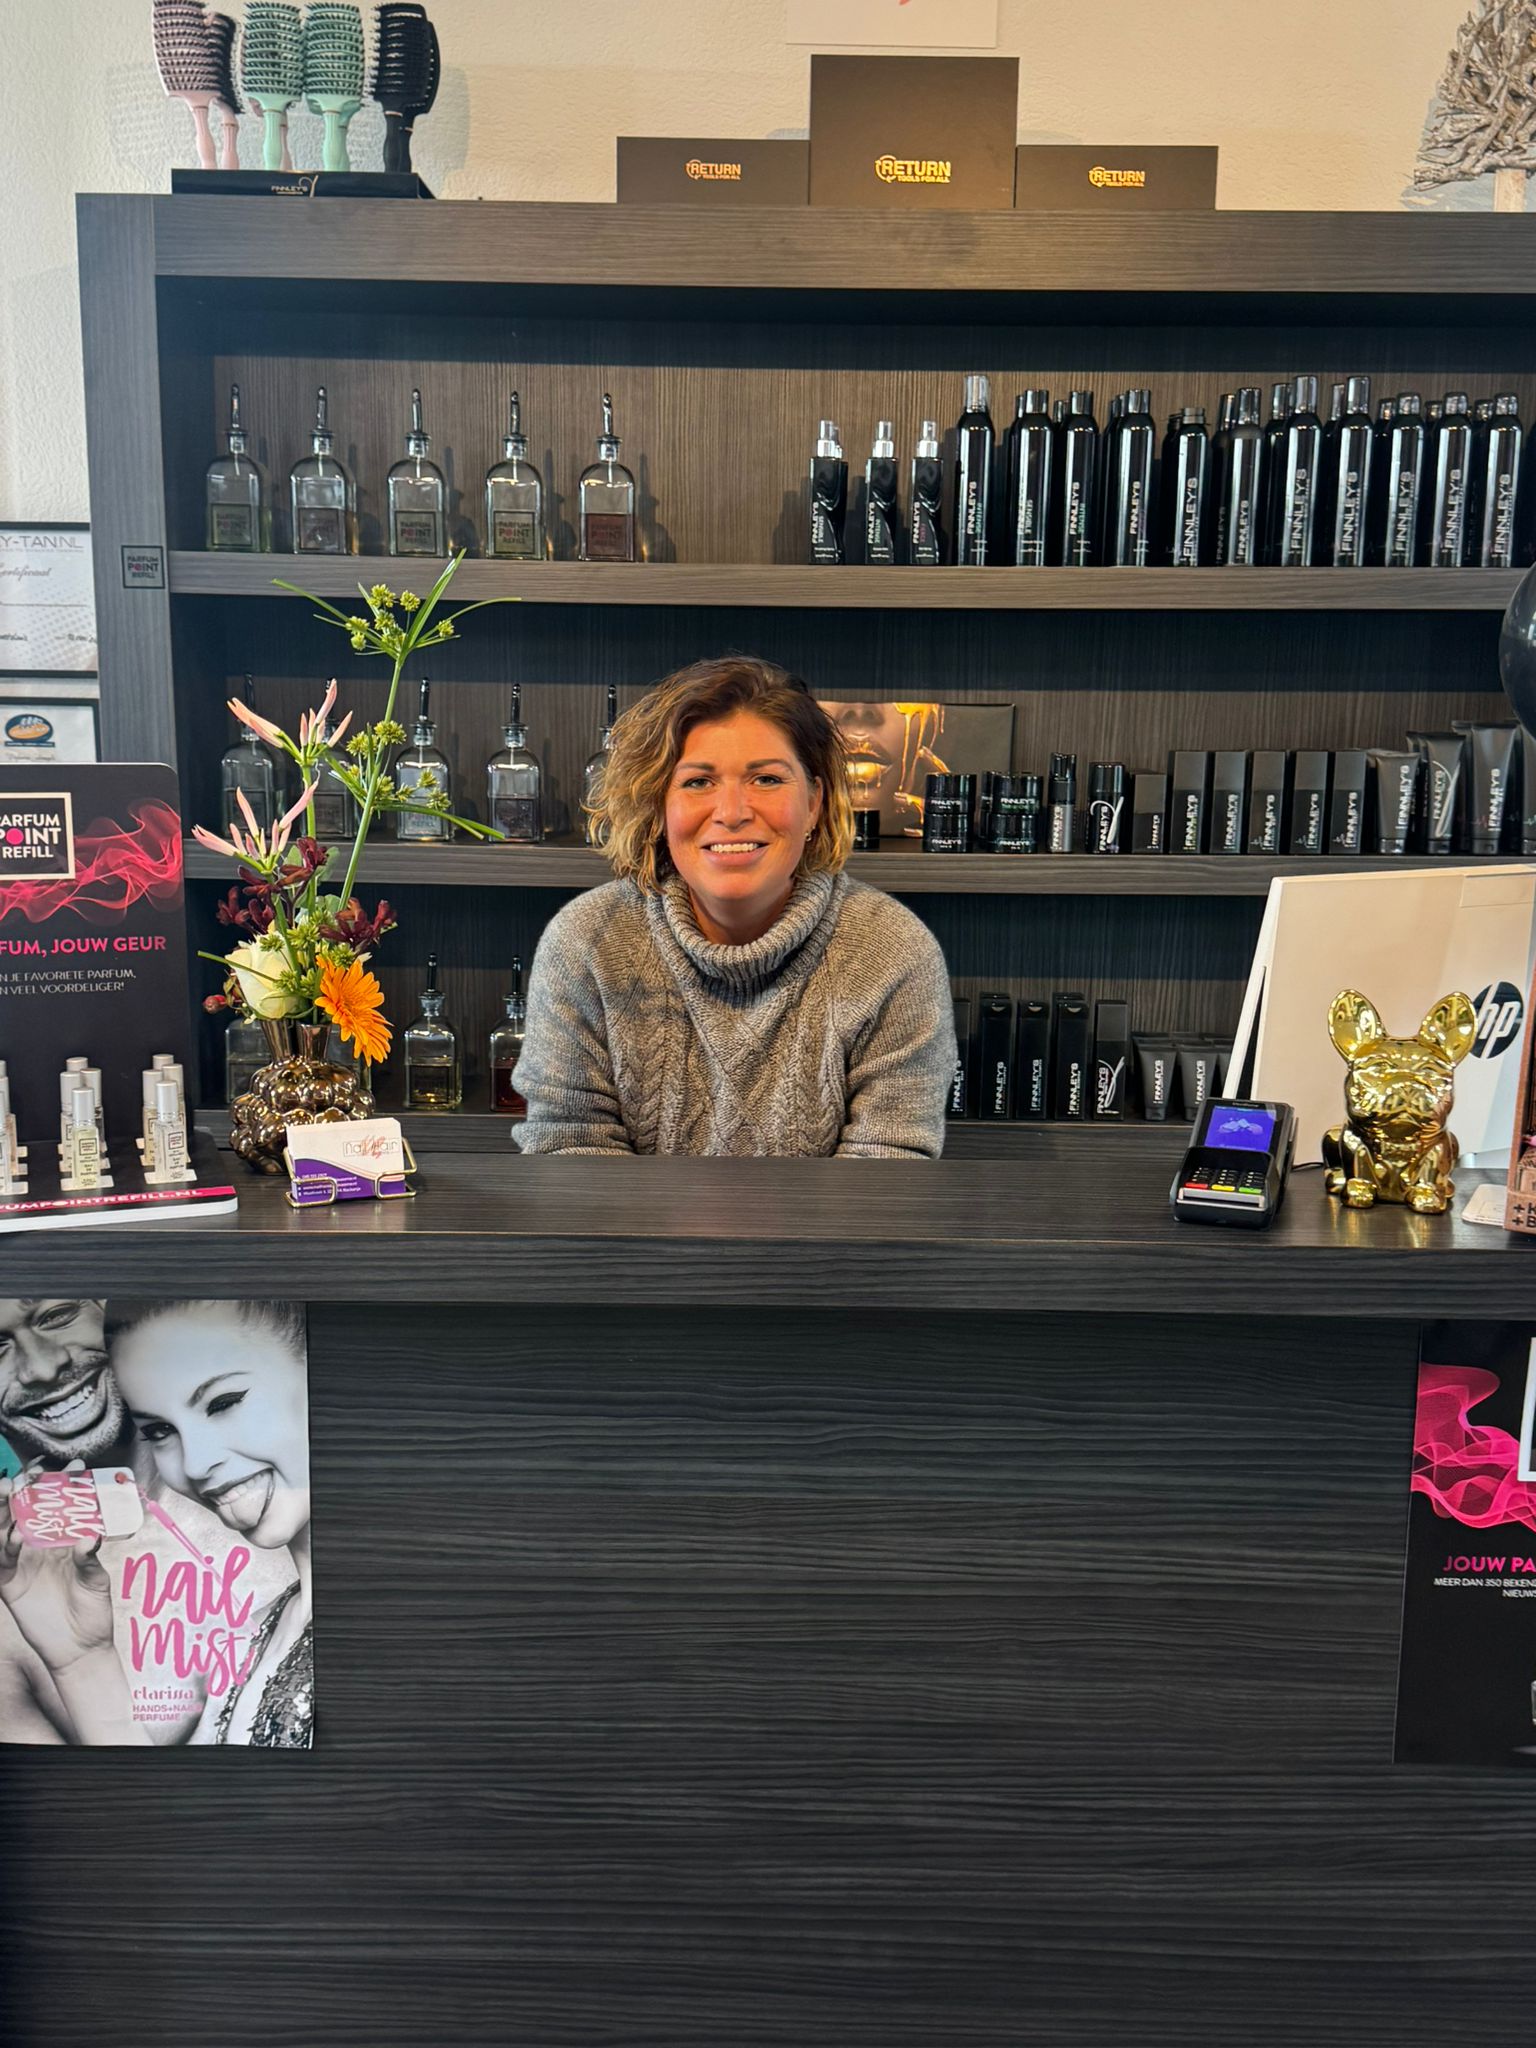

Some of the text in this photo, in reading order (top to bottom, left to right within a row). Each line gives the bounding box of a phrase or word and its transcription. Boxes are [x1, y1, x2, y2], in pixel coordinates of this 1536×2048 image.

[691, 163, 741, 175] RETURN
[882, 160, 951, 176] RETURN
[1094, 170, 1145, 182] RETURN
[812, 501, 820, 544] FINNLEY'S
[868, 501, 876, 544] FINNLEY'S
[912, 501, 921, 544] FINNLEY'S
[966, 481, 977, 535] FINNLEY'S
[1069, 481, 1080, 535] FINNLEY'S
[1129, 481, 1141, 535] FINNLEY'S
[1184, 477, 1198, 556] FINNLEY'S
[1238, 500, 1249, 556] FINNLEY'S
[1291, 468, 1307, 549] FINNLEY'S
[1342, 471, 1358, 551] FINNLEY'S
[1395, 471, 1412, 551] FINNLEY'S
[1444, 468, 1462, 549] FINNLEY'S
[1494, 473, 1511, 554] FINNLEY'S
[128, 563, 159, 571] POINT
[1225, 794, 1237, 845] FINNLEY'S
[1308, 793, 1319, 845] FINNLEY'S
[1346, 792, 1358, 844] FINNLEY'S
[1398, 765, 1411, 825] FINNLEY'S
[1488, 768, 1500, 828] FINNLEY'S
[0, 814, 60, 827] ARFUM
[1099, 805, 1109, 851] FINNLEY'S
[1185, 794, 1197, 847] FINNLEY'S
[1264, 795, 1275, 847] FINNLEY'S
[2, 847, 54, 858] REFILL
[51, 937, 108, 954] JOUW
[113, 935, 167, 952] GEUR
[10, 973, 21, 982] JE
[24, 970, 85, 982] FAVORIETE
[87, 968, 137, 979] PARFUM,
[10, 985, 37, 995] VEEL
[40, 981, 125, 993] VOORDELIGER!
[995, 1061, 1005, 1111] FINNLEY'S
[1031, 1058, 1041, 1109] FINNLEY'S
[1069, 1062, 1079, 1112] FINNLEY'S
[1153, 1060, 1164, 1102] FINNLEY'S
[1433, 1577, 1461, 1586] MEER
[1462, 1578, 1483, 1587] DAN
[1485, 1578, 1502, 1587] 350
[1443, 1555, 1507, 1573] JOUW
[132, 1713, 181, 1721] PERFUME
